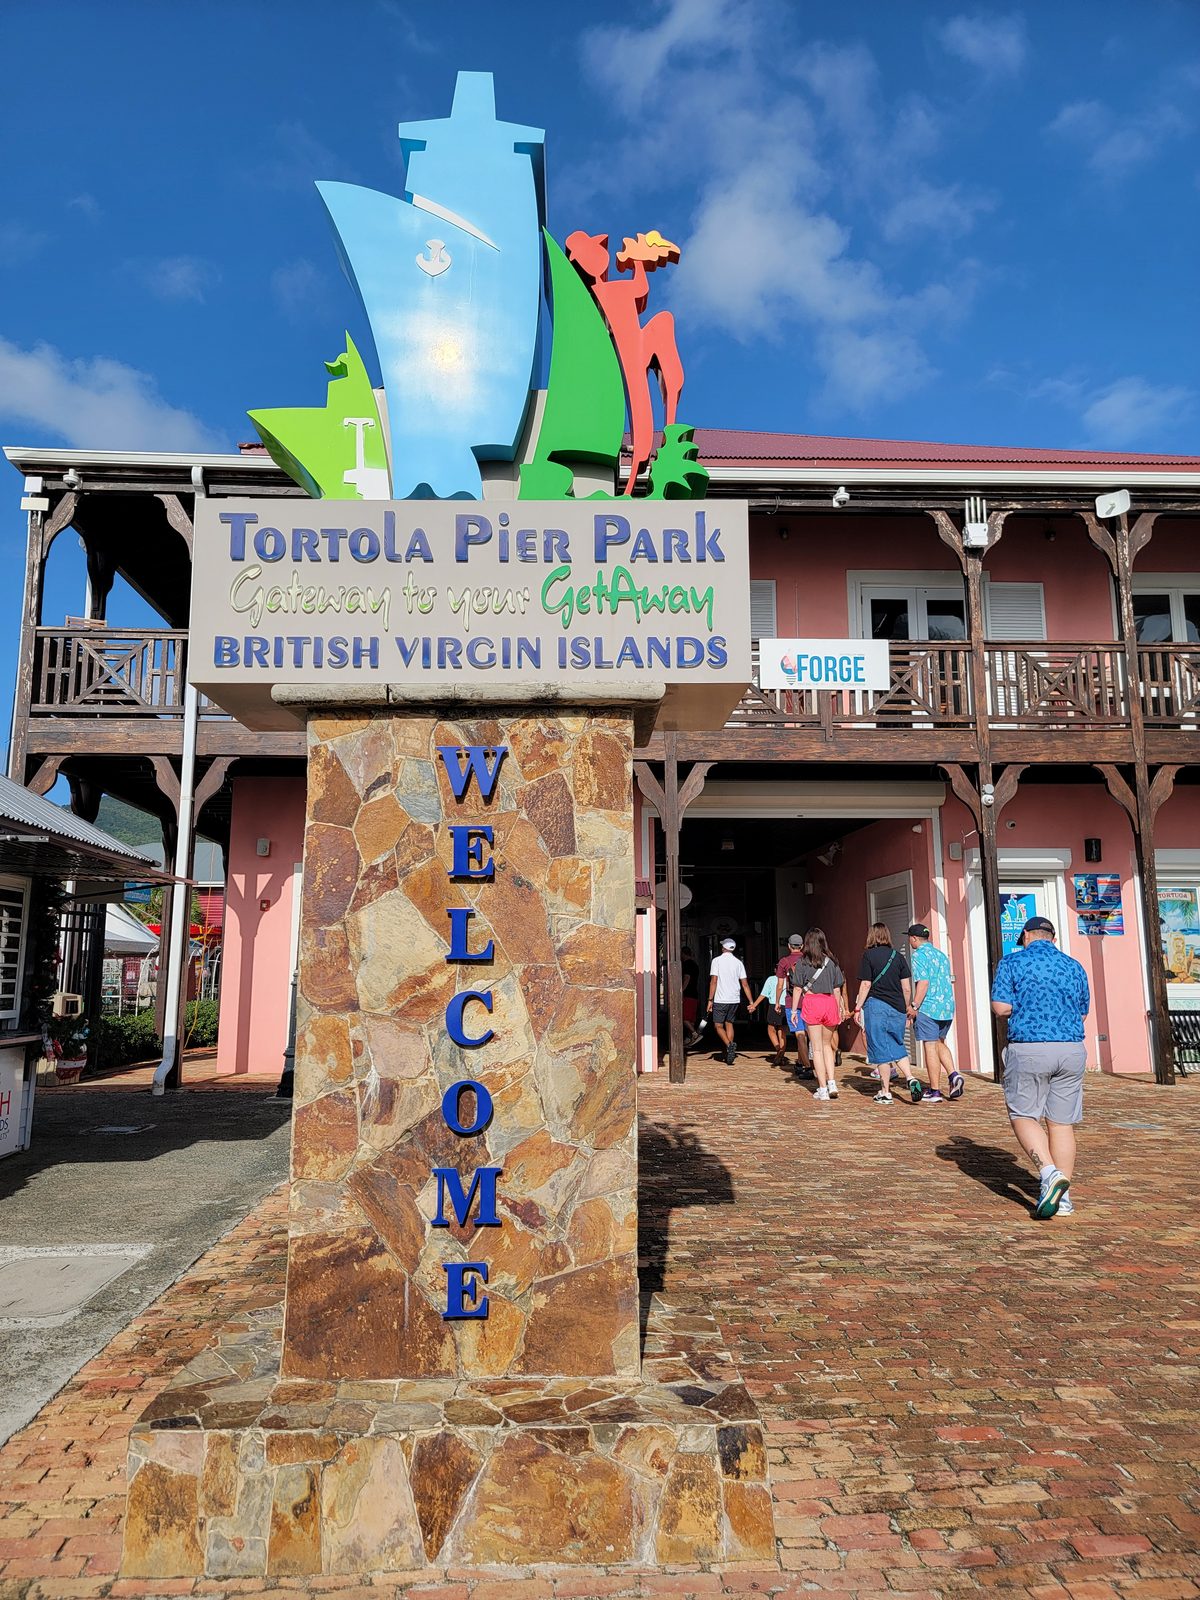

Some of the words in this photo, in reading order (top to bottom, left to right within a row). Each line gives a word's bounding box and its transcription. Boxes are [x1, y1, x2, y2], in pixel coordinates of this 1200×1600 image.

[230, 564, 391, 631] Gateway
[403, 570, 438, 614] to
[447, 586, 530, 631] your
[541, 565, 714, 631] GetAway
[213, 635, 380, 669] BRITISH
[395, 636, 541, 669] VIRGIN
[558, 635, 728, 669] ISLANDS
[797, 654, 866, 682] FORGE
[430, 746, 508, 1320] WELCOME
